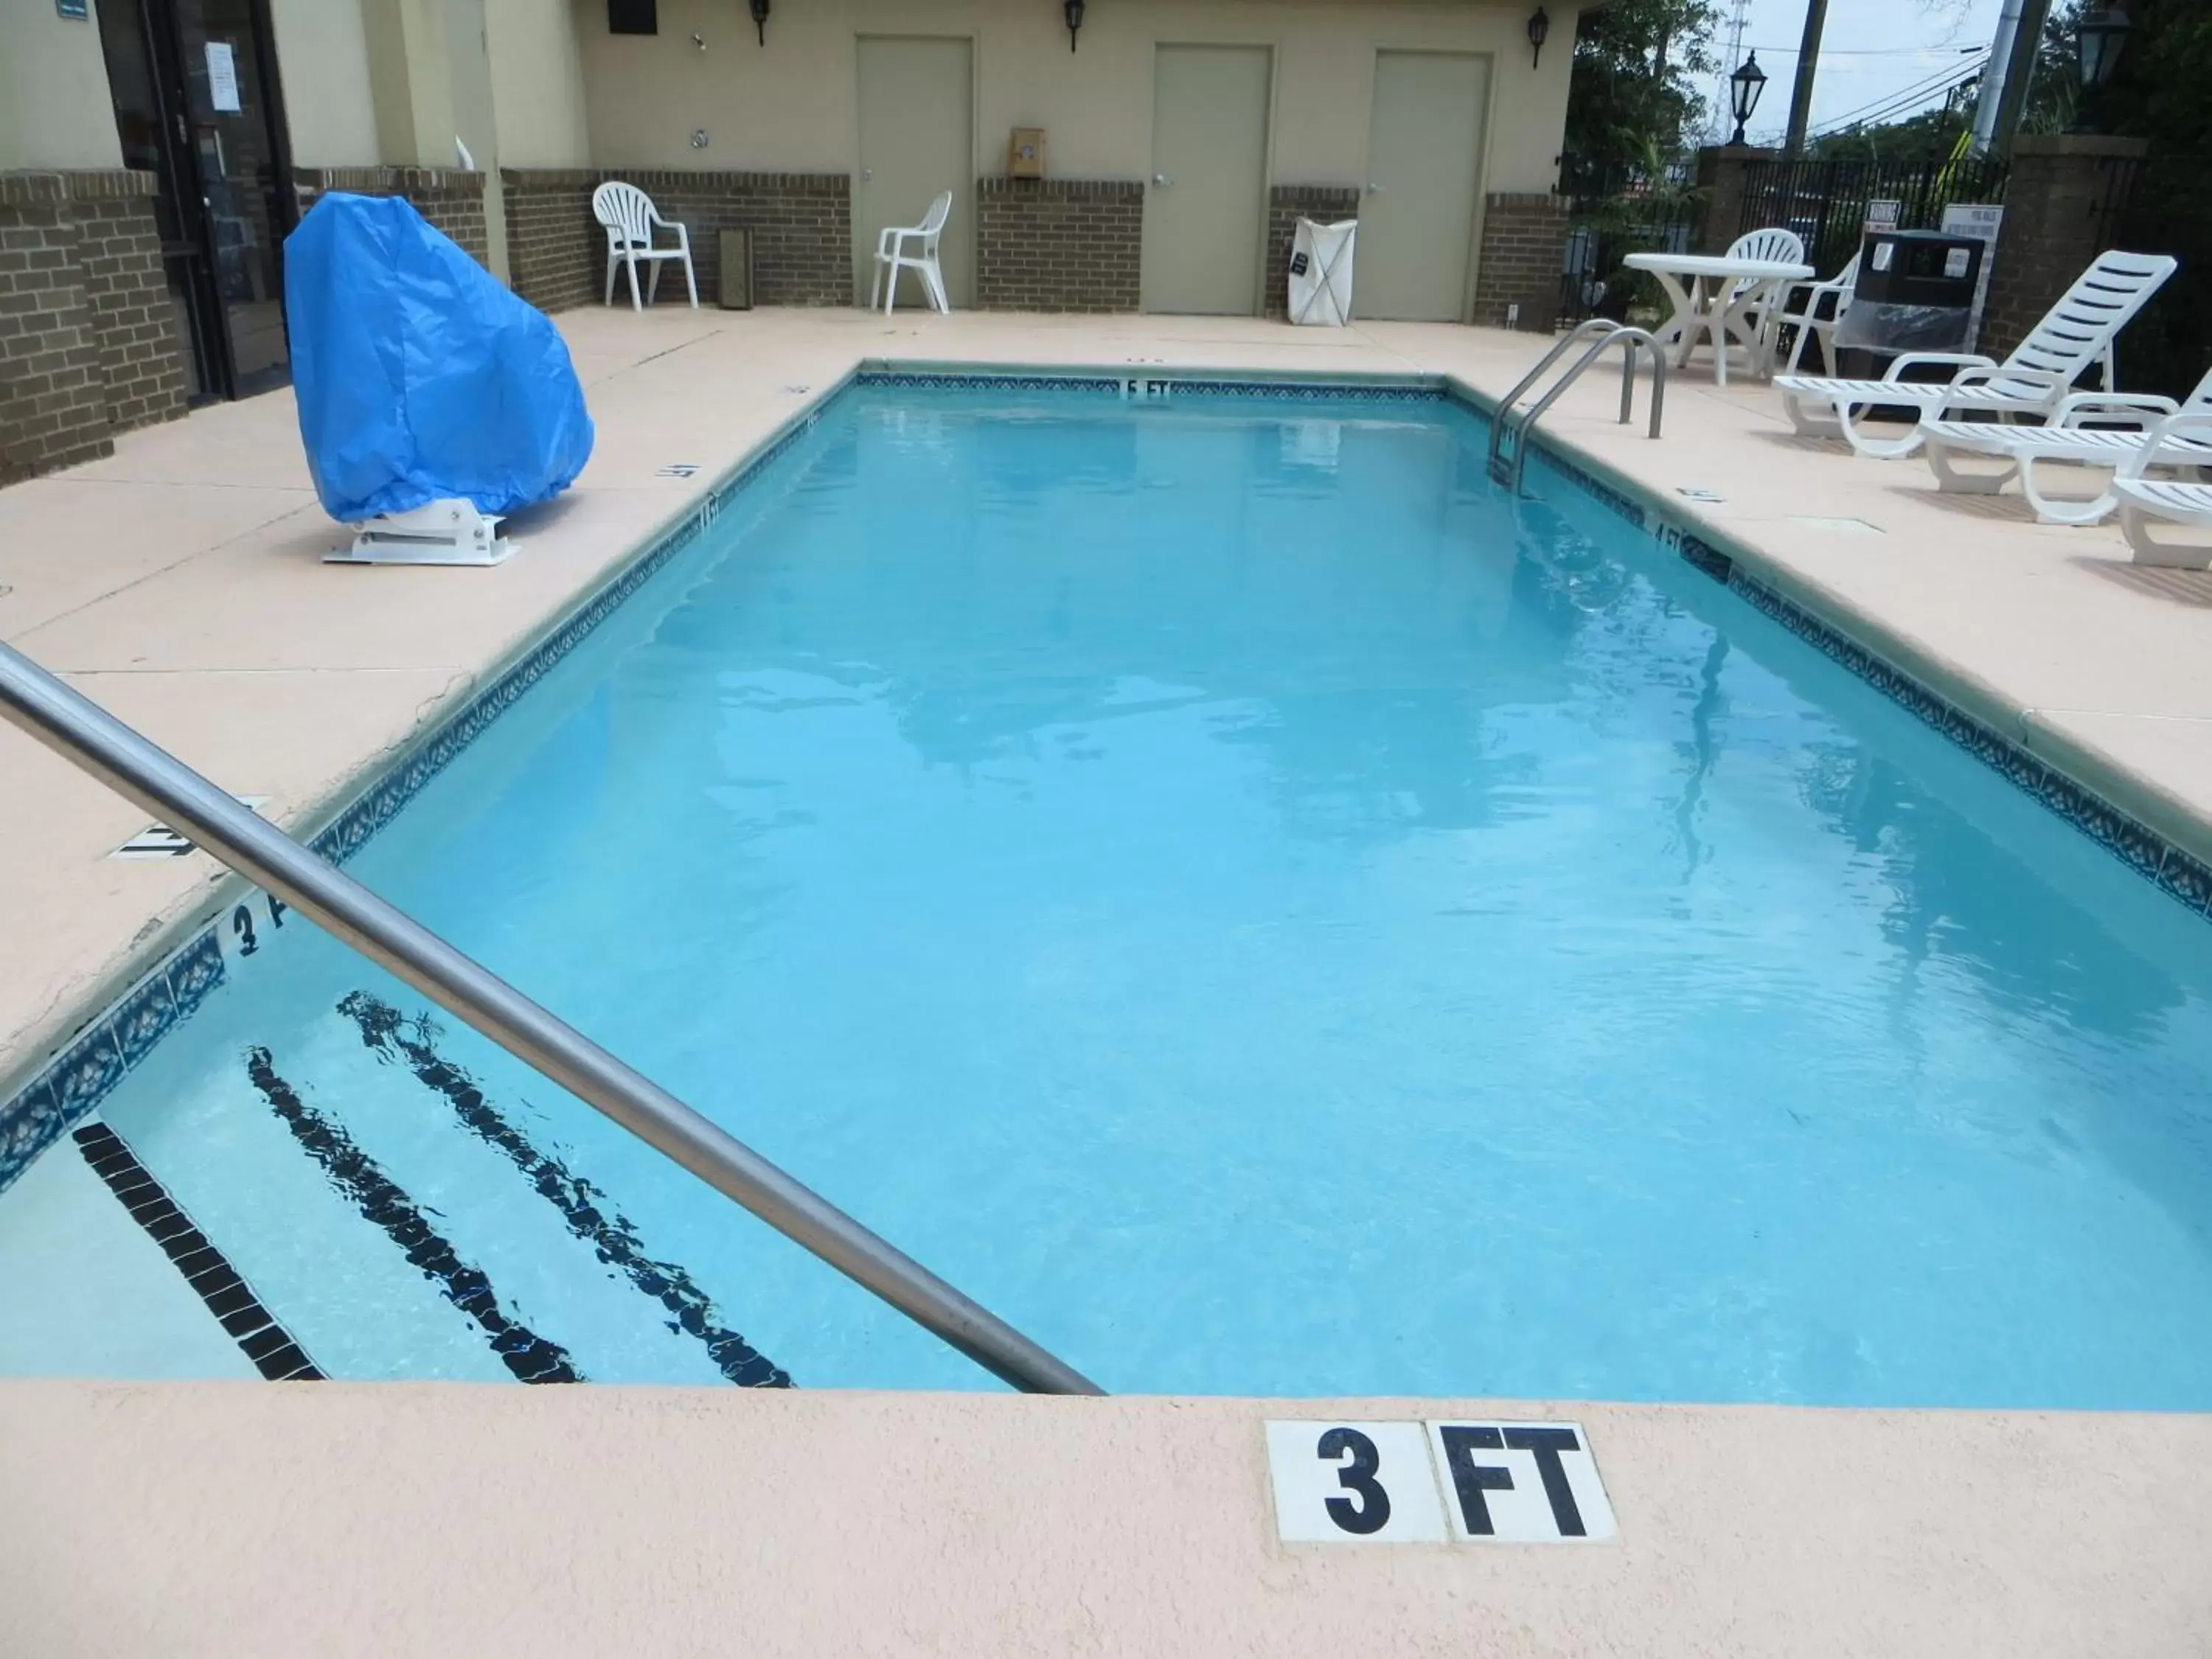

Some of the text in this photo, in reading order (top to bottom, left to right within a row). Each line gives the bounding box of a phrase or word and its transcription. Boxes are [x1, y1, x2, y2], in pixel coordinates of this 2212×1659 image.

[1147, 380, 1169, 396] FT
[1318, 1425, 1588, 1537] 3 FT
